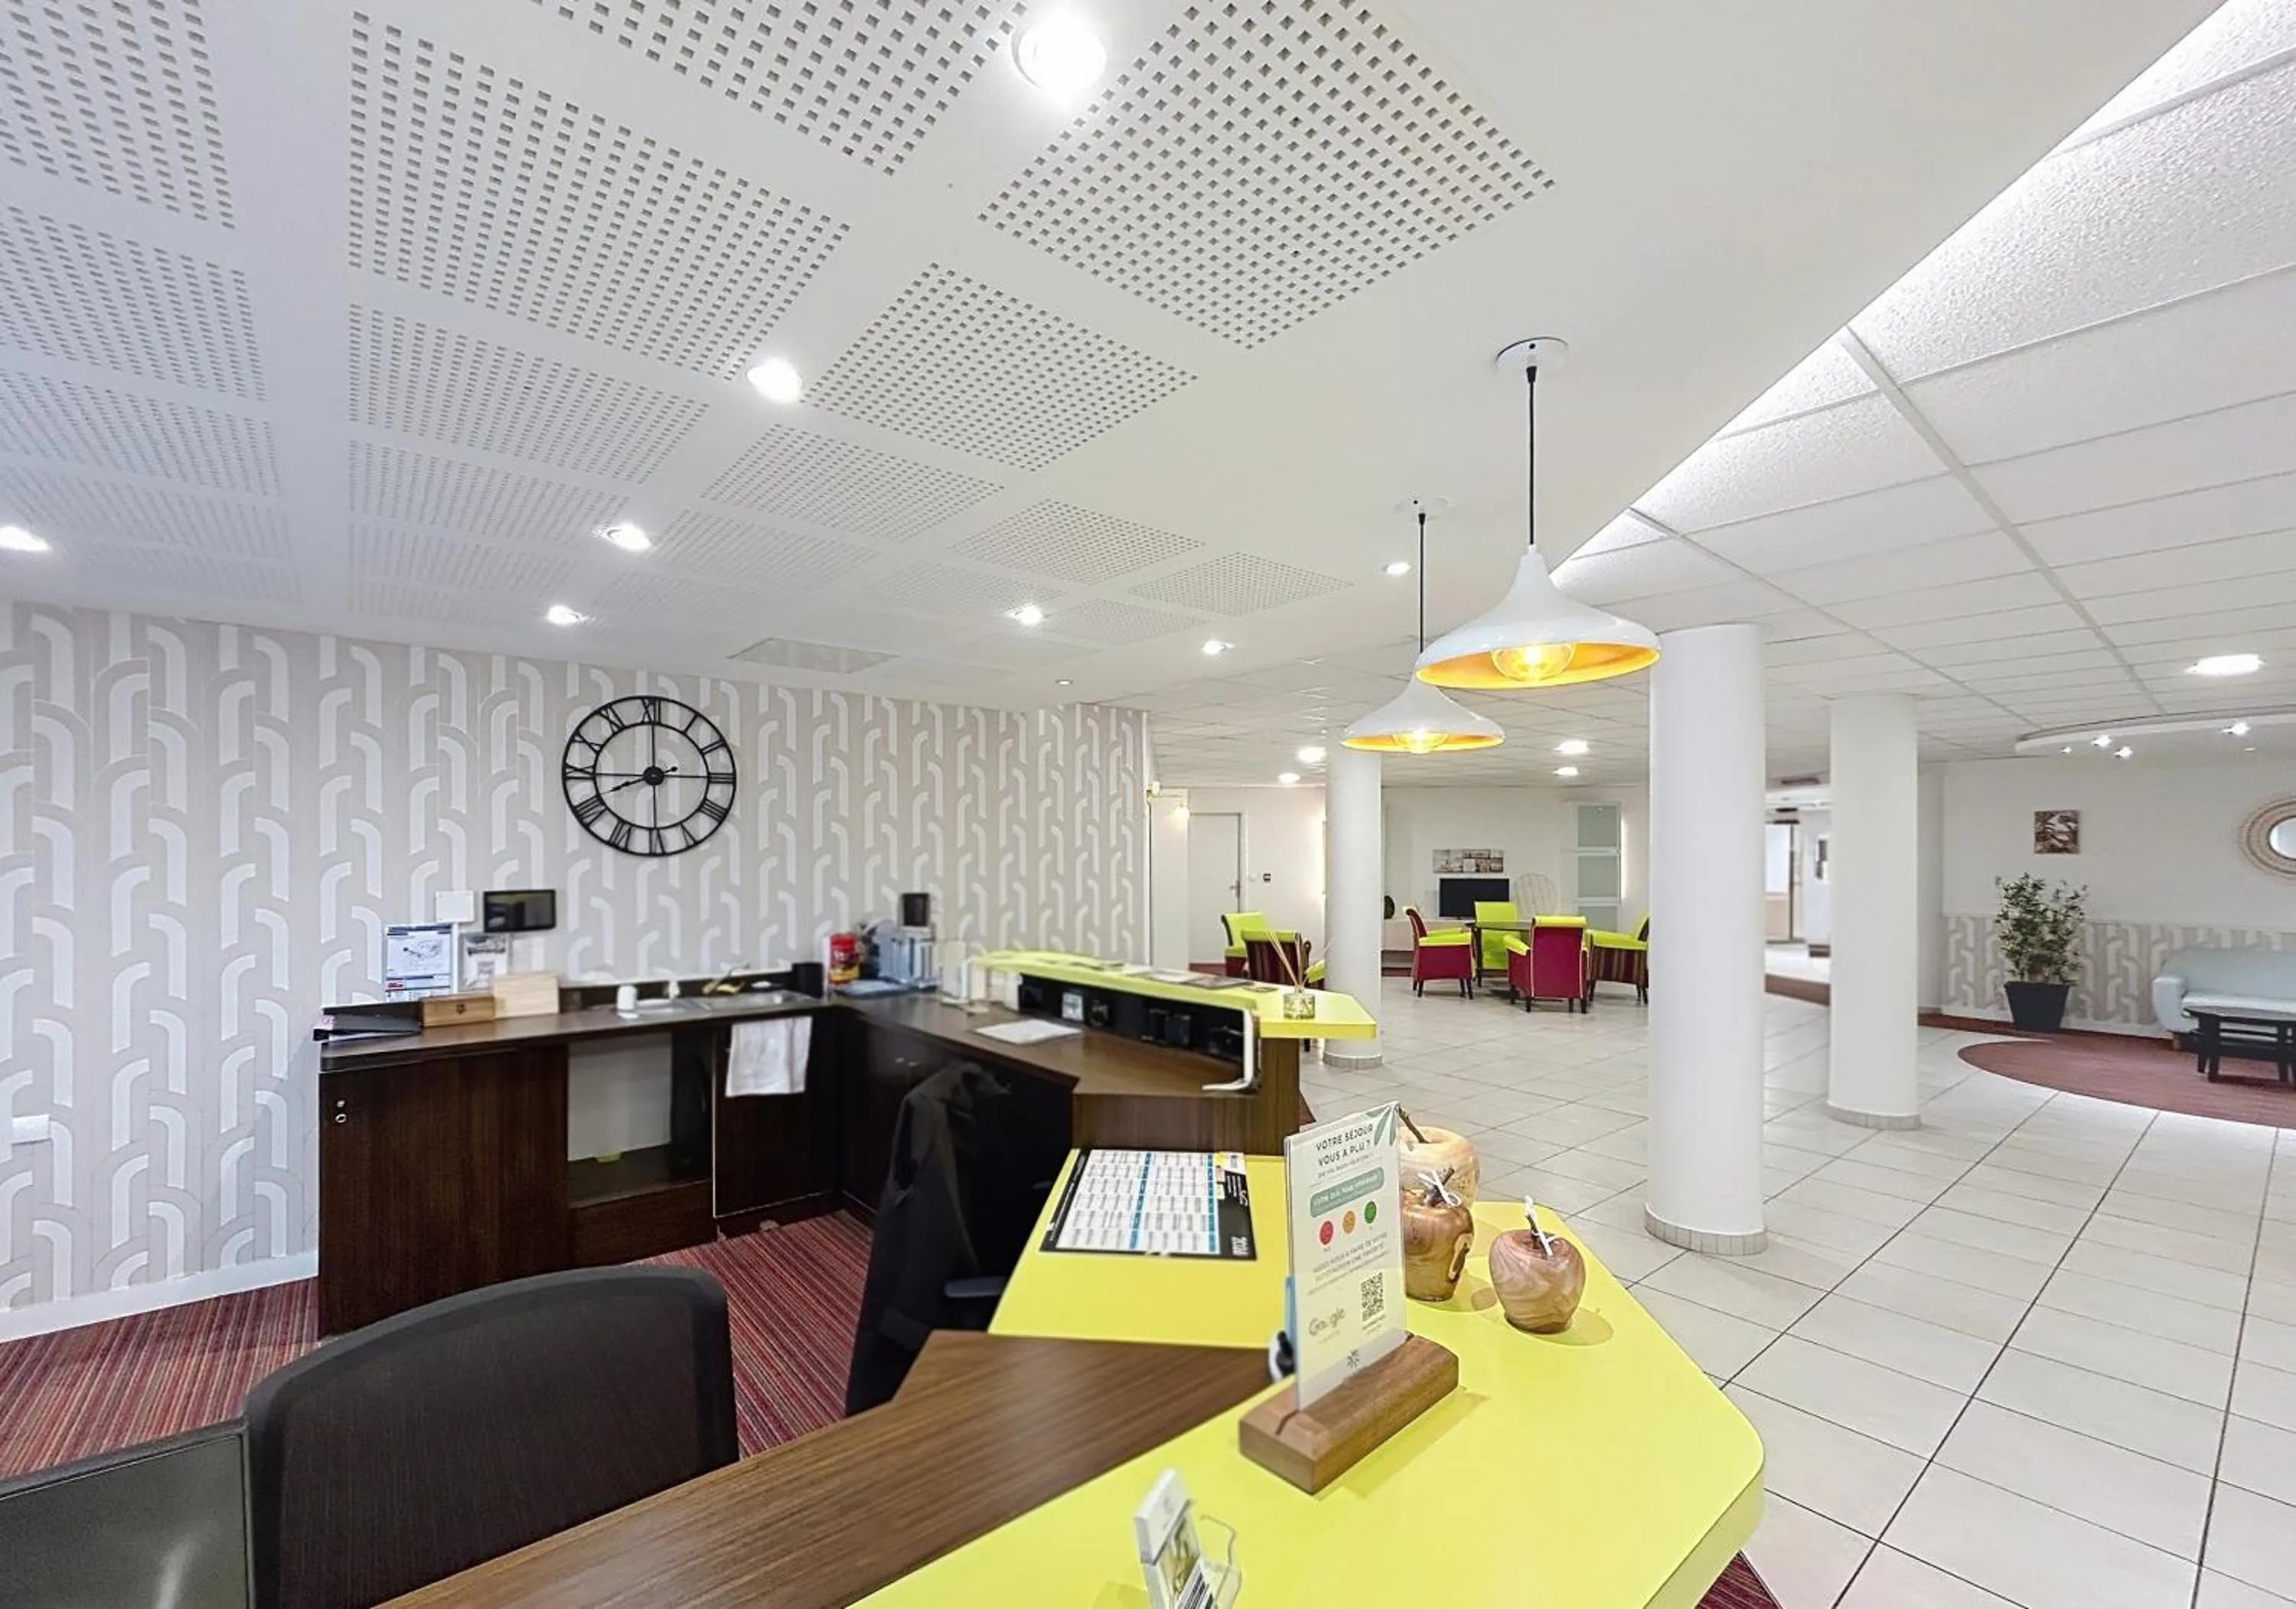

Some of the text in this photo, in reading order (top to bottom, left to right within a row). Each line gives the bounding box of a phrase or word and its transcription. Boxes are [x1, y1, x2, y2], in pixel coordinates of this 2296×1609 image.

[641, 697, 661, 723] XII
[1316, 1134, 1342, 1151] VOTRE
[1318, 1150, 1340, 1166] VOUS
[1309, 1307, 1345, 1336] Gogle
